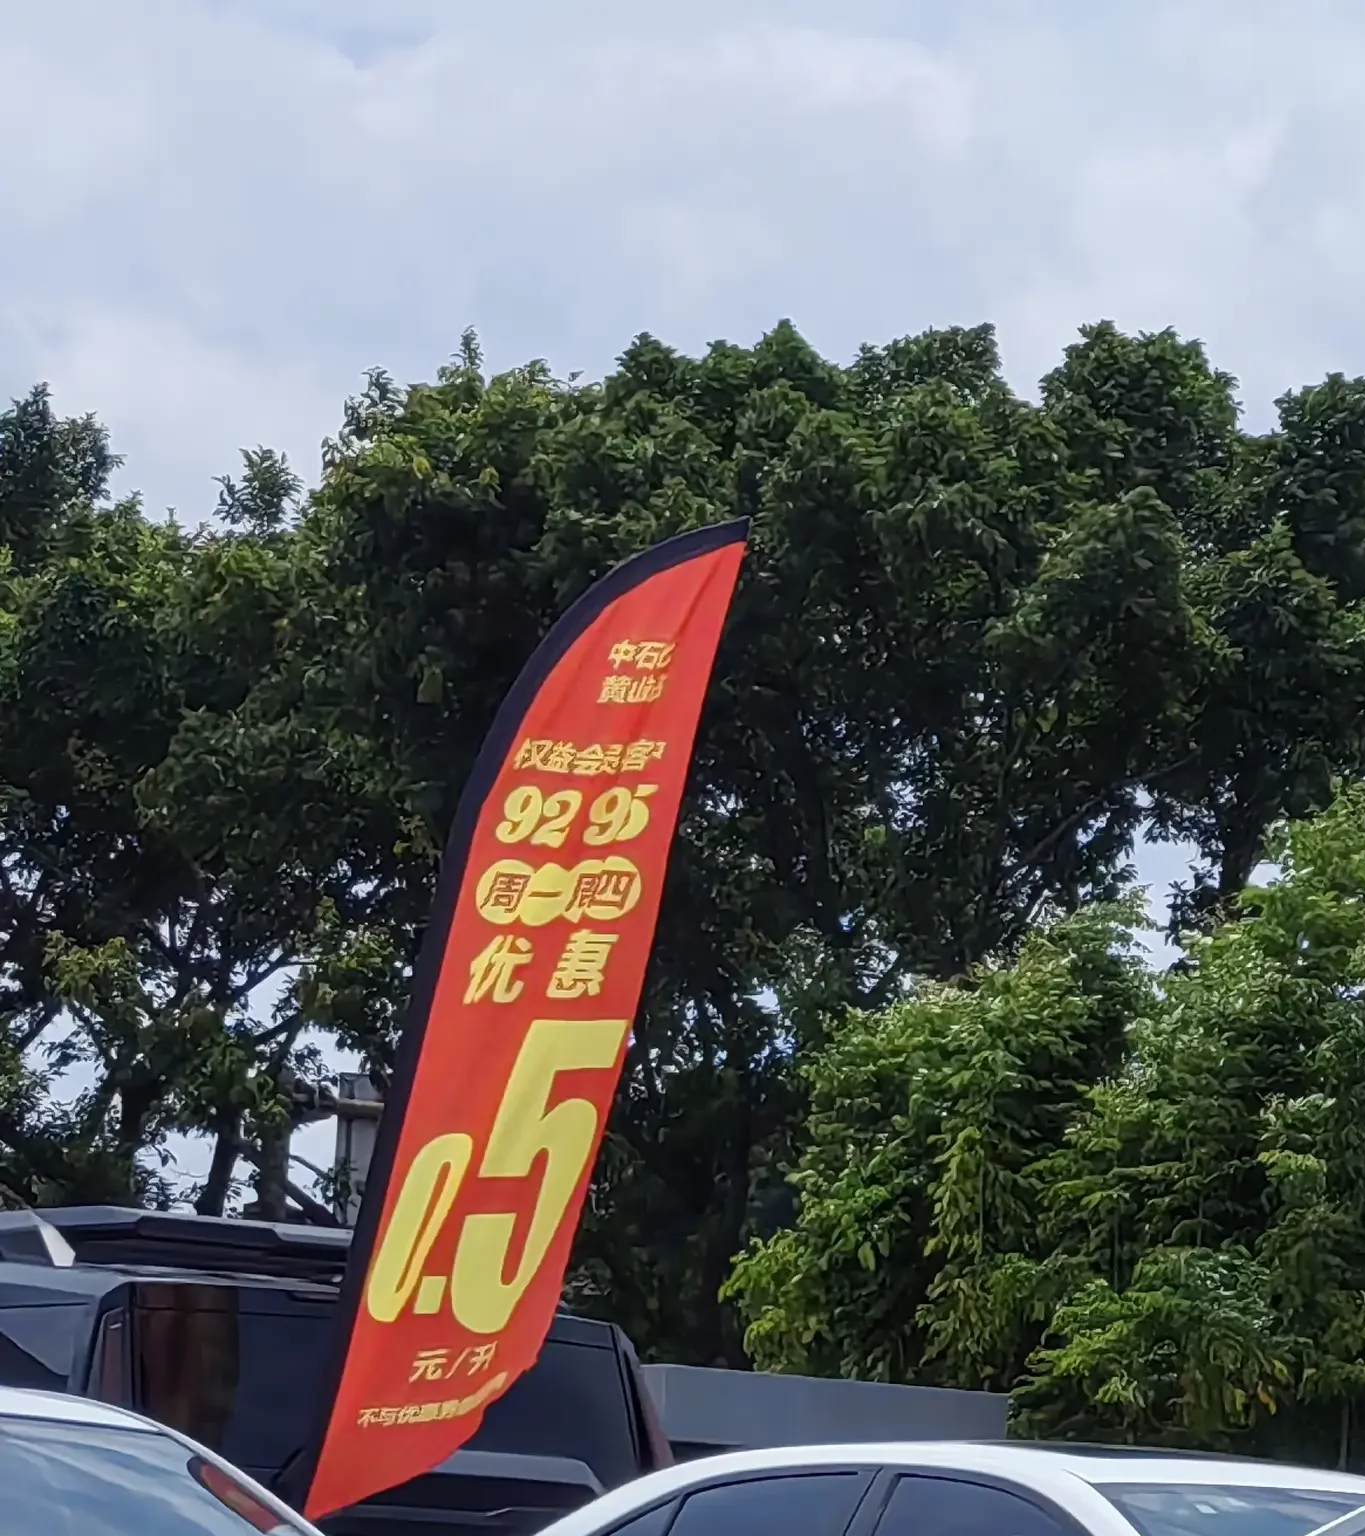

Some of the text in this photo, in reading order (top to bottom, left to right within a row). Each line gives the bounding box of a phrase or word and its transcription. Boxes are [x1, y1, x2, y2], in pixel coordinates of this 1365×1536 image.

[494, 785, 583, 848] 92
[462, 929, 620, 1006] 优惠
[366, 1018, 630, 1334] 0.5
